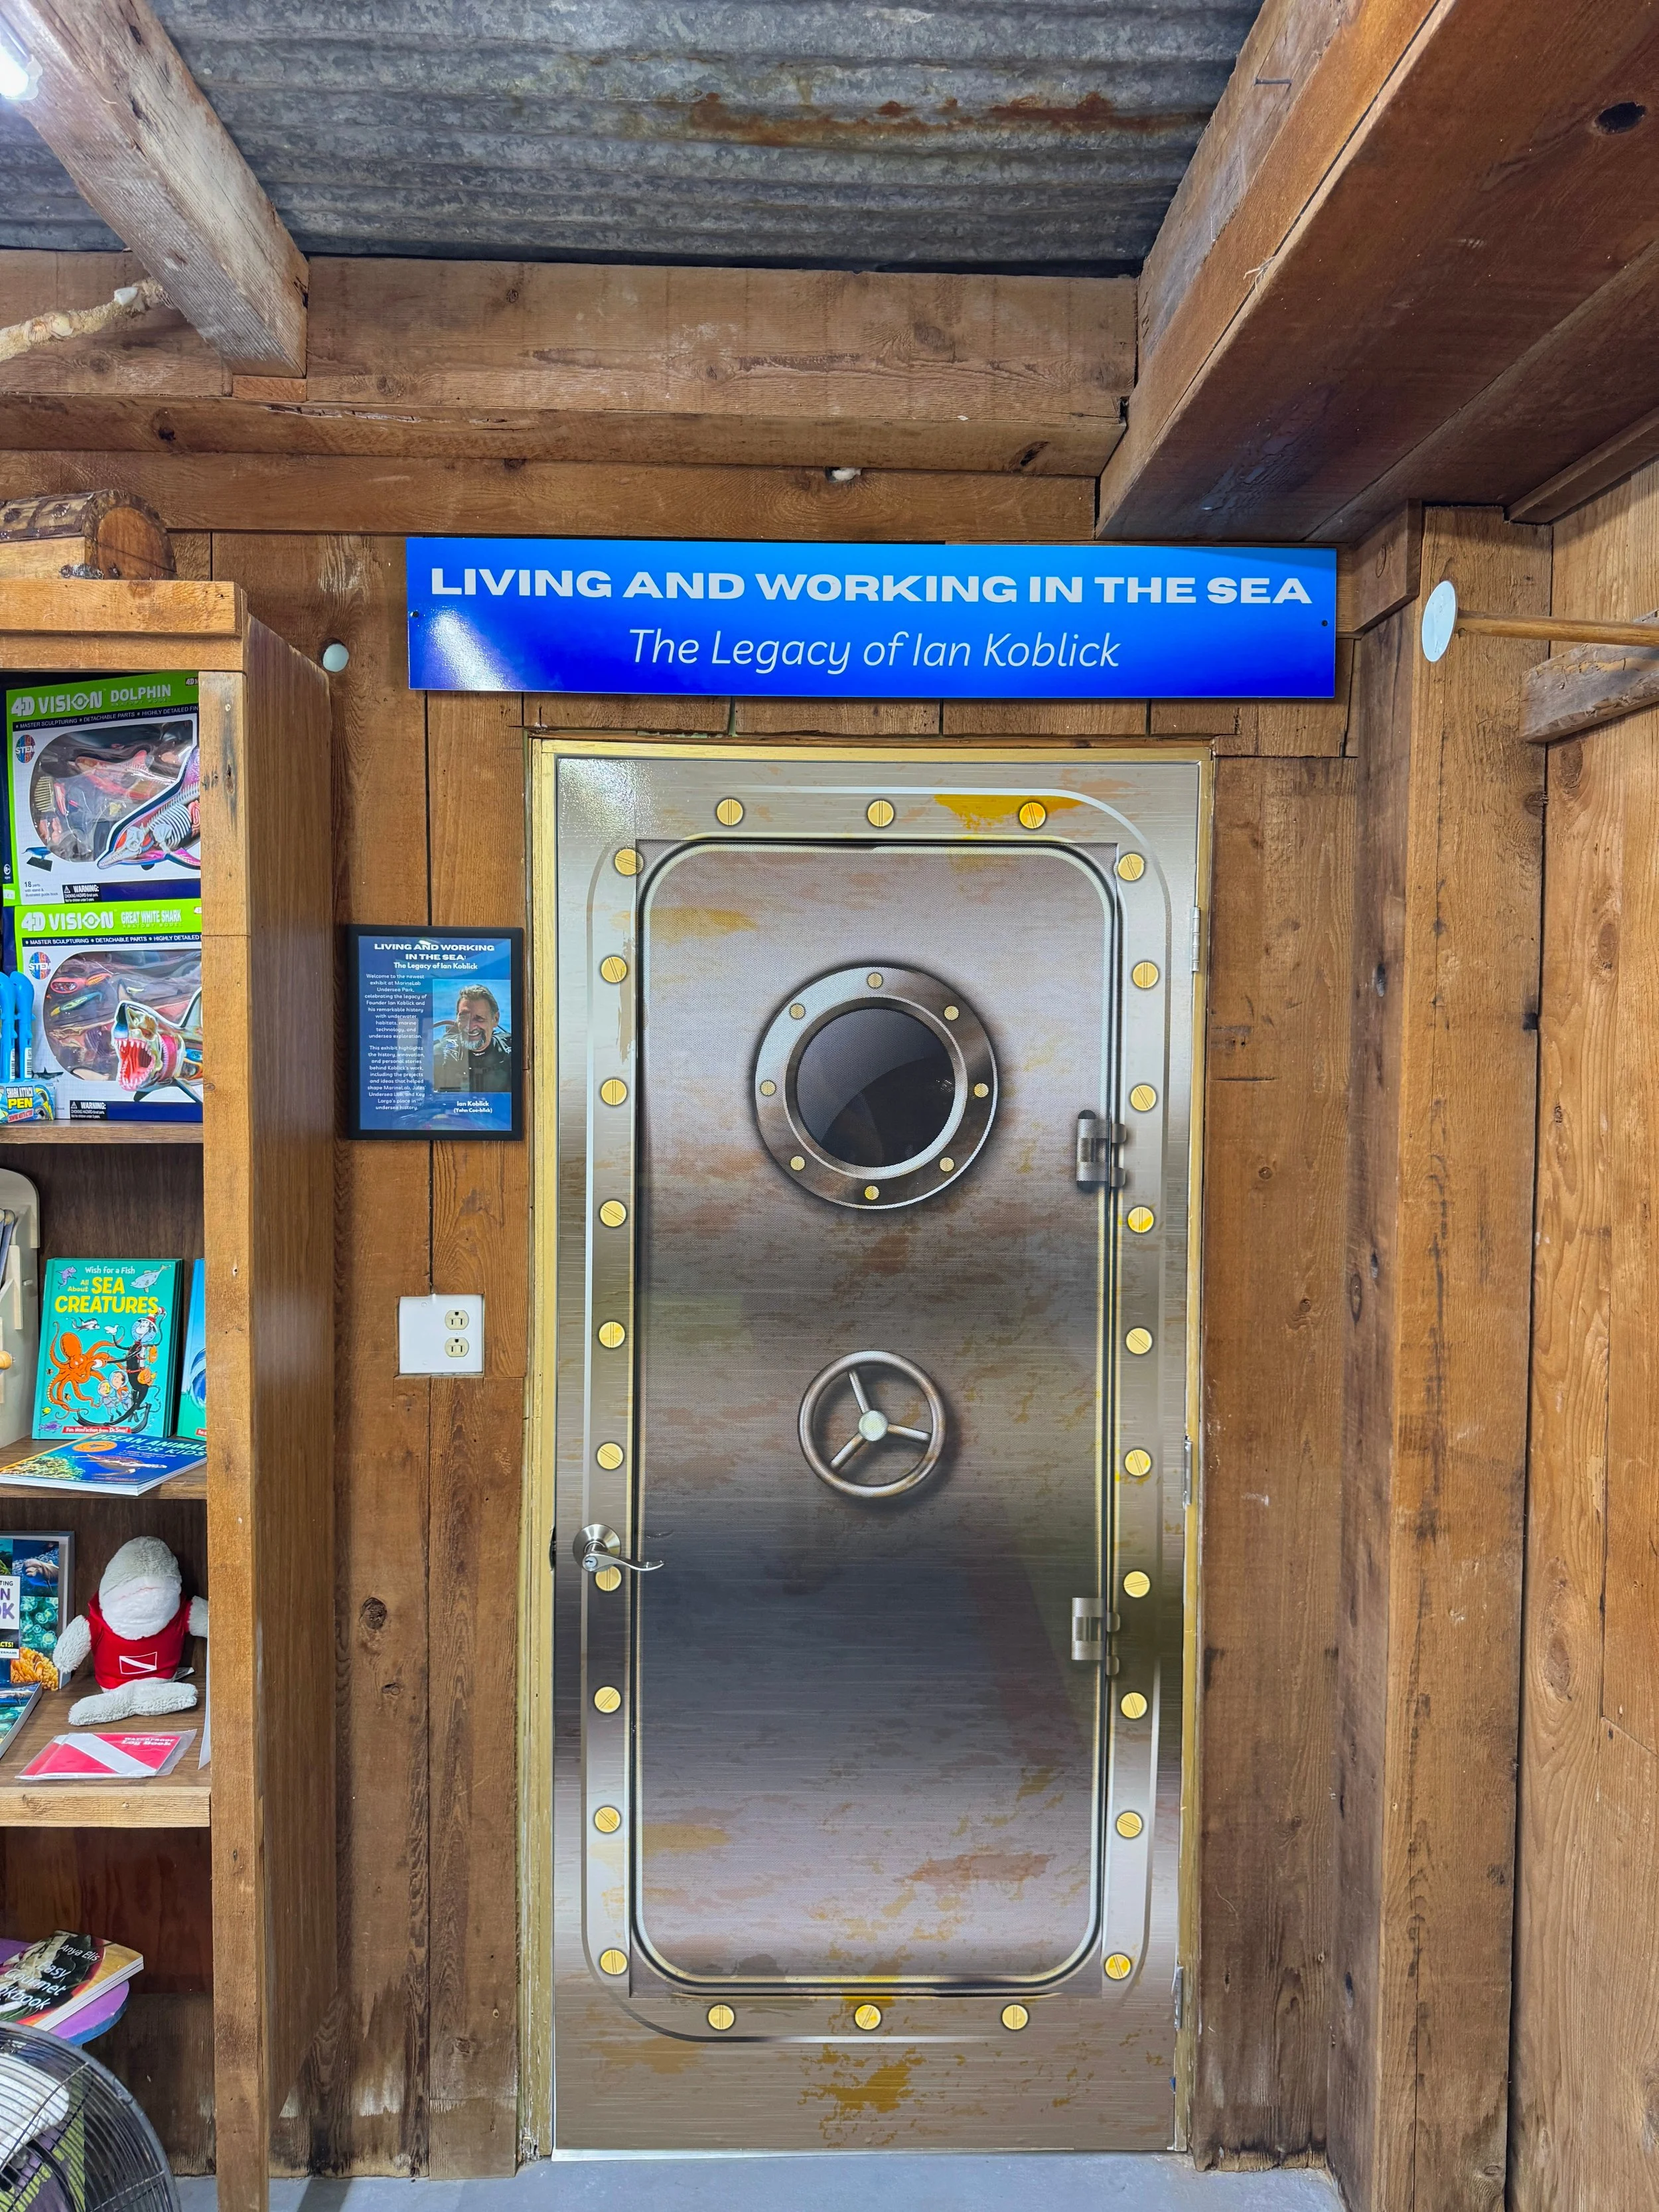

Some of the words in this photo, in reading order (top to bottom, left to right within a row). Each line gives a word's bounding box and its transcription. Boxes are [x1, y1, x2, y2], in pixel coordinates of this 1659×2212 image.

[431, 567, 612, 598] LIVING
[622, 571, 745, 599] AND
[755, 573, 1017, 604] WORKING
[1029, 576, 1083, 603] IN
[1094, 577, 1196, 604] THE
[1206, 577, 1313, 605] SEA
[629, 627, 699, 664] The
[711, 629, 851, 675] Legacy
[863, 630, 910, 666] of
[913, 632, 971, 667] Ian
[983, 632, 1121, 667] Koblick
[110, 684, 171, 702] DOLPHIN
[11, 696, 35, 717] 4D
[38, 690, 103, 715] VISION
[41, 718, 78, 727] SCULPTURING
[73, 884, 100, 893] WARNING:
[21, 912, 46, 932] 4D
[48, 911, 114, 930] VISION
[121, 911, 140, 924] GREAT
[141, 910, 160, 924] WHITE
[161, 909, 182, 922] SHARK
[7, 1097, 33, 1110] PEN
[84, 1266, 102, 1274] Wish
[103, 1266, 114, 1274] for
[121, 1266, 135, 1275] Fish
[91, 1276, 125, 1295] SEA
[54, 1295, 159, 1315] CREATURES
[91, 1434, 145, 1445] OCEAN
[126, 1444, 161, 1453] FOR
[166, 1448, 207, 1457] KIDS
[0, 1602, 15, 1620] K
[59, 1944, 83, 1956] Anya
[82, 1951, 101, 1962] Elis
[36, 1961, 72, 1979] Easy
[4, 1968, 68, 1996] Gourmet
